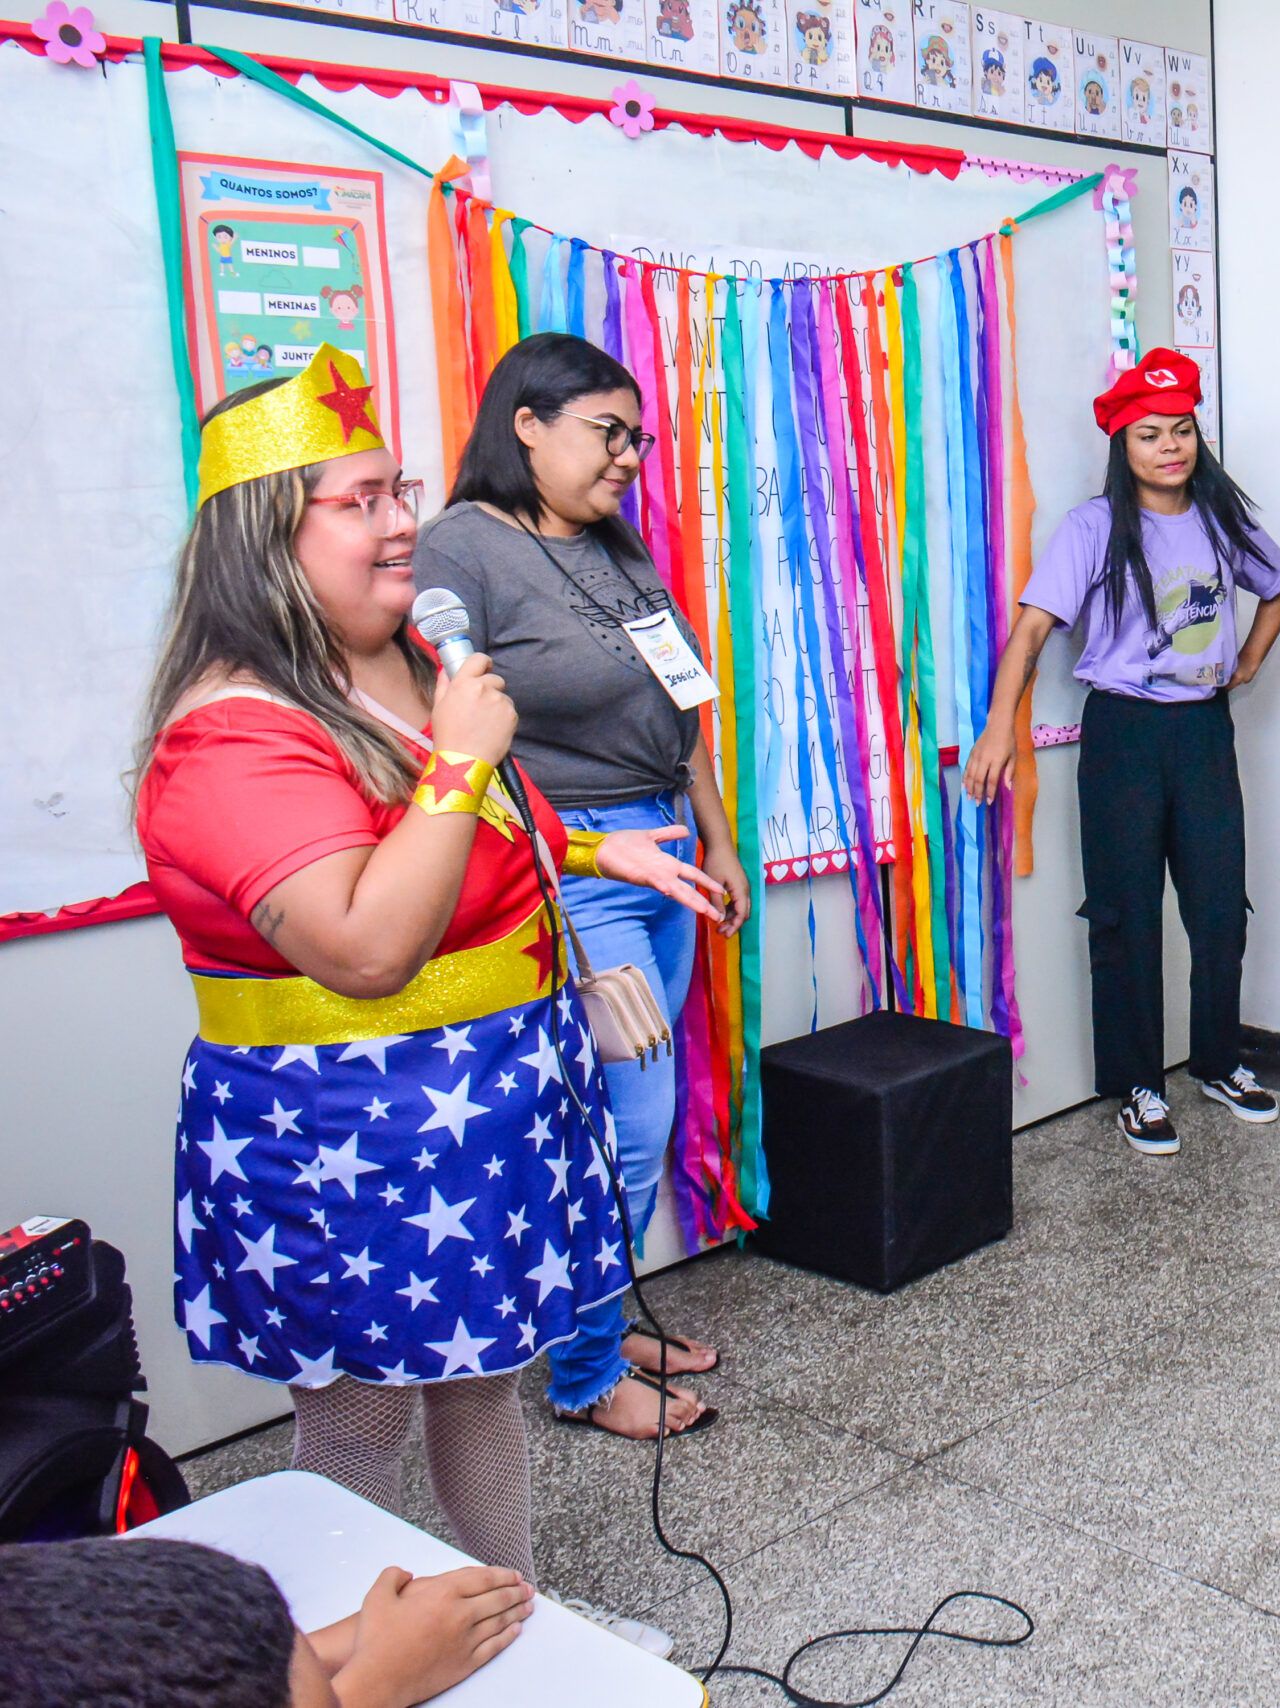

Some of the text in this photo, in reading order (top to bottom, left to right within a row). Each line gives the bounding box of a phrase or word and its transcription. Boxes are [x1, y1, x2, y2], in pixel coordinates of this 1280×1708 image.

[219, 178, 318, 199] QUANTOS SOMOS?
[246, 248, 296, 260] MENINOS
[729, 259, 763, 298] DO
[268, 300, 317, 312] MENINAS
